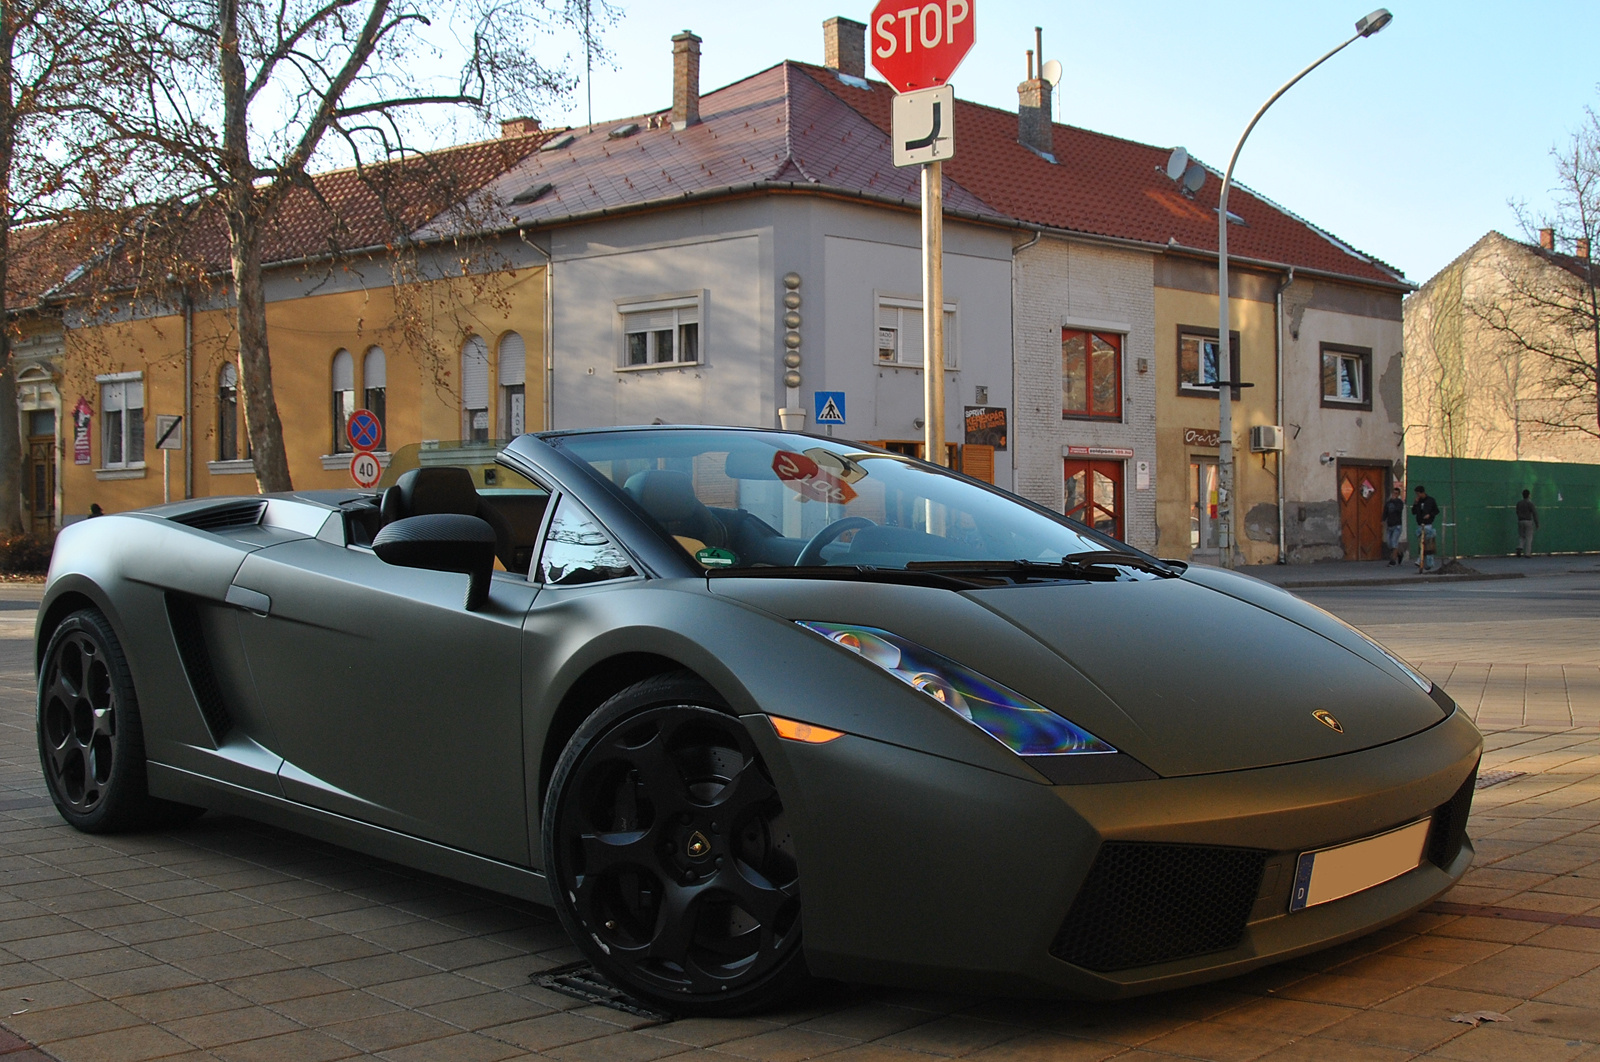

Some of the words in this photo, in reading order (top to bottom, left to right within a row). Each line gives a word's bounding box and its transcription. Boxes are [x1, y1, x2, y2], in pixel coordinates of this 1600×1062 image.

[876, 0, 969, 59] STOP
[359, 463, 373, 477] 40
[1298, 888, 1304, 899] D
